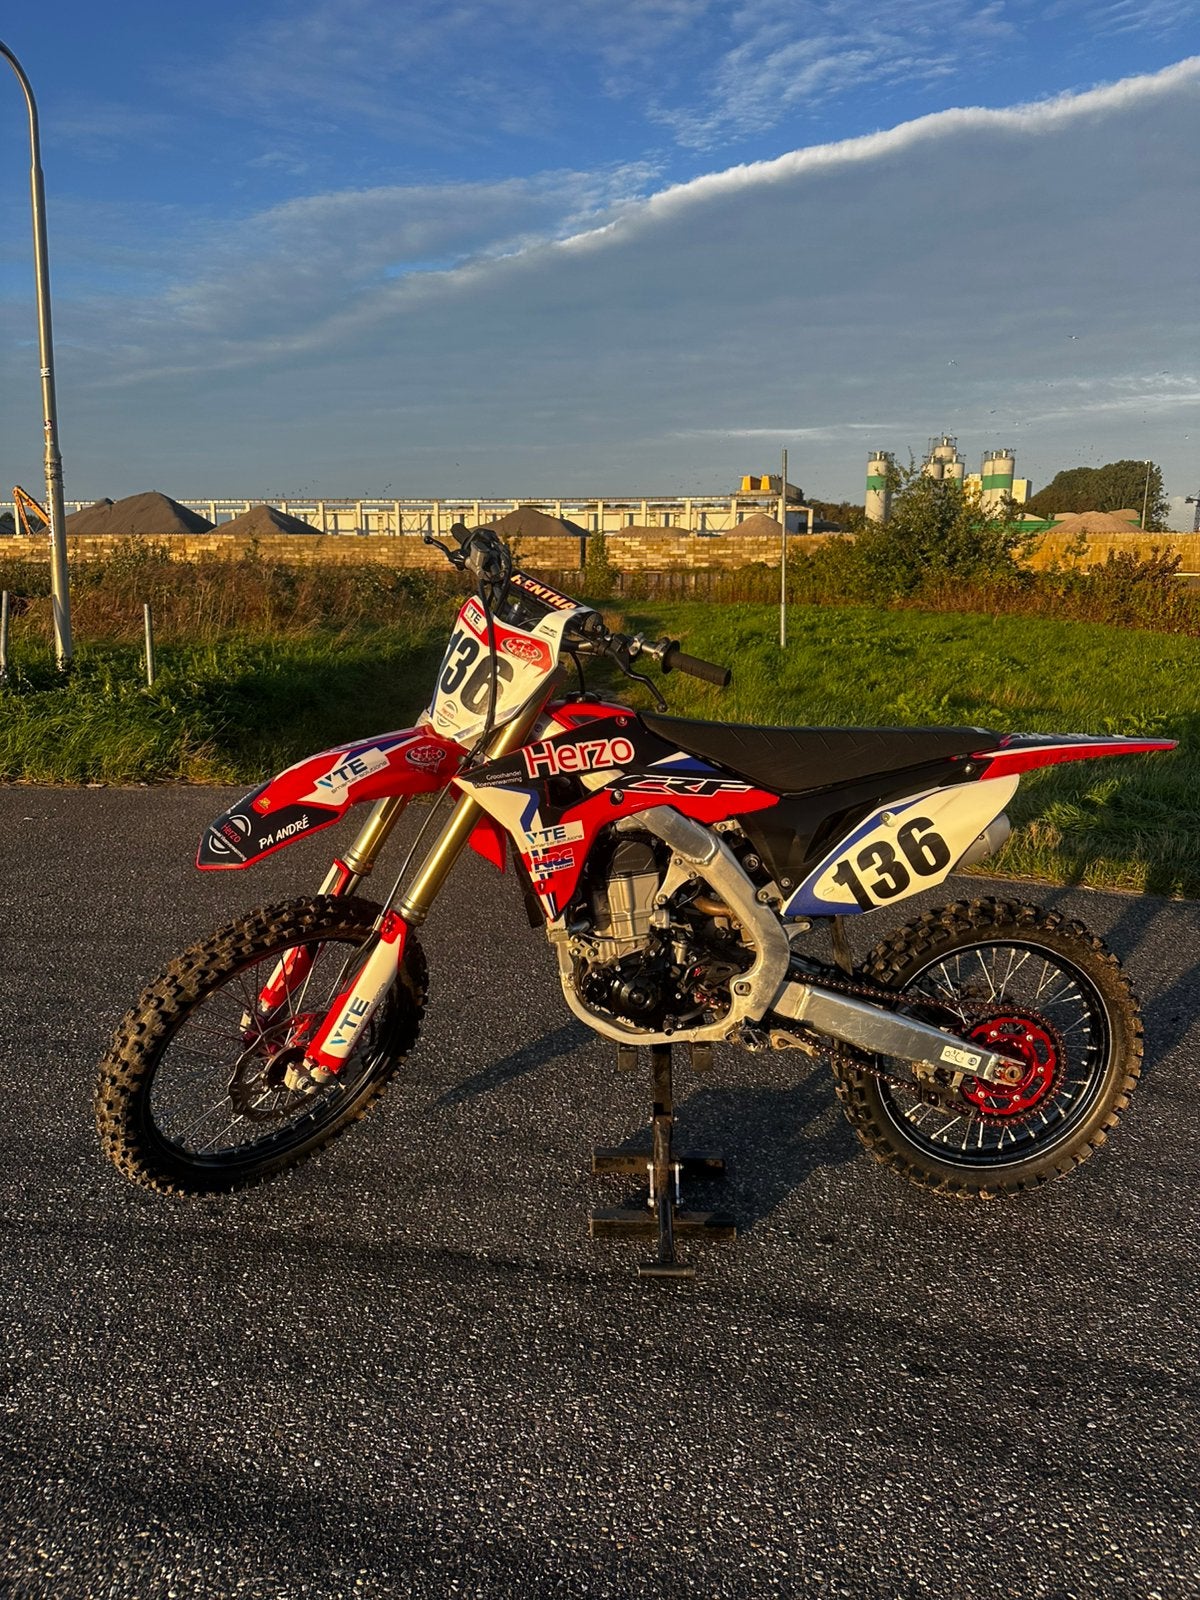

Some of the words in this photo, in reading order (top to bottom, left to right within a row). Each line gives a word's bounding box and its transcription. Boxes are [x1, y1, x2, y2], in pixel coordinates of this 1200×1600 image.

[510, 574, 578, 610] RENTHA
[440, 629, 514, 716] 136
[486, 770, 522, 781] Groothandel
[522, 737, 635, 779] Herzo
[604, 774, 755, 797] CRF
[221, 822, 242, 843] Herzo
[259, 834, 274, 849] PA
[276, 814, 310, 841] ANDRÉ
[533, 848, 575, 871] HRC
[832, 817, 951, 912] 136
